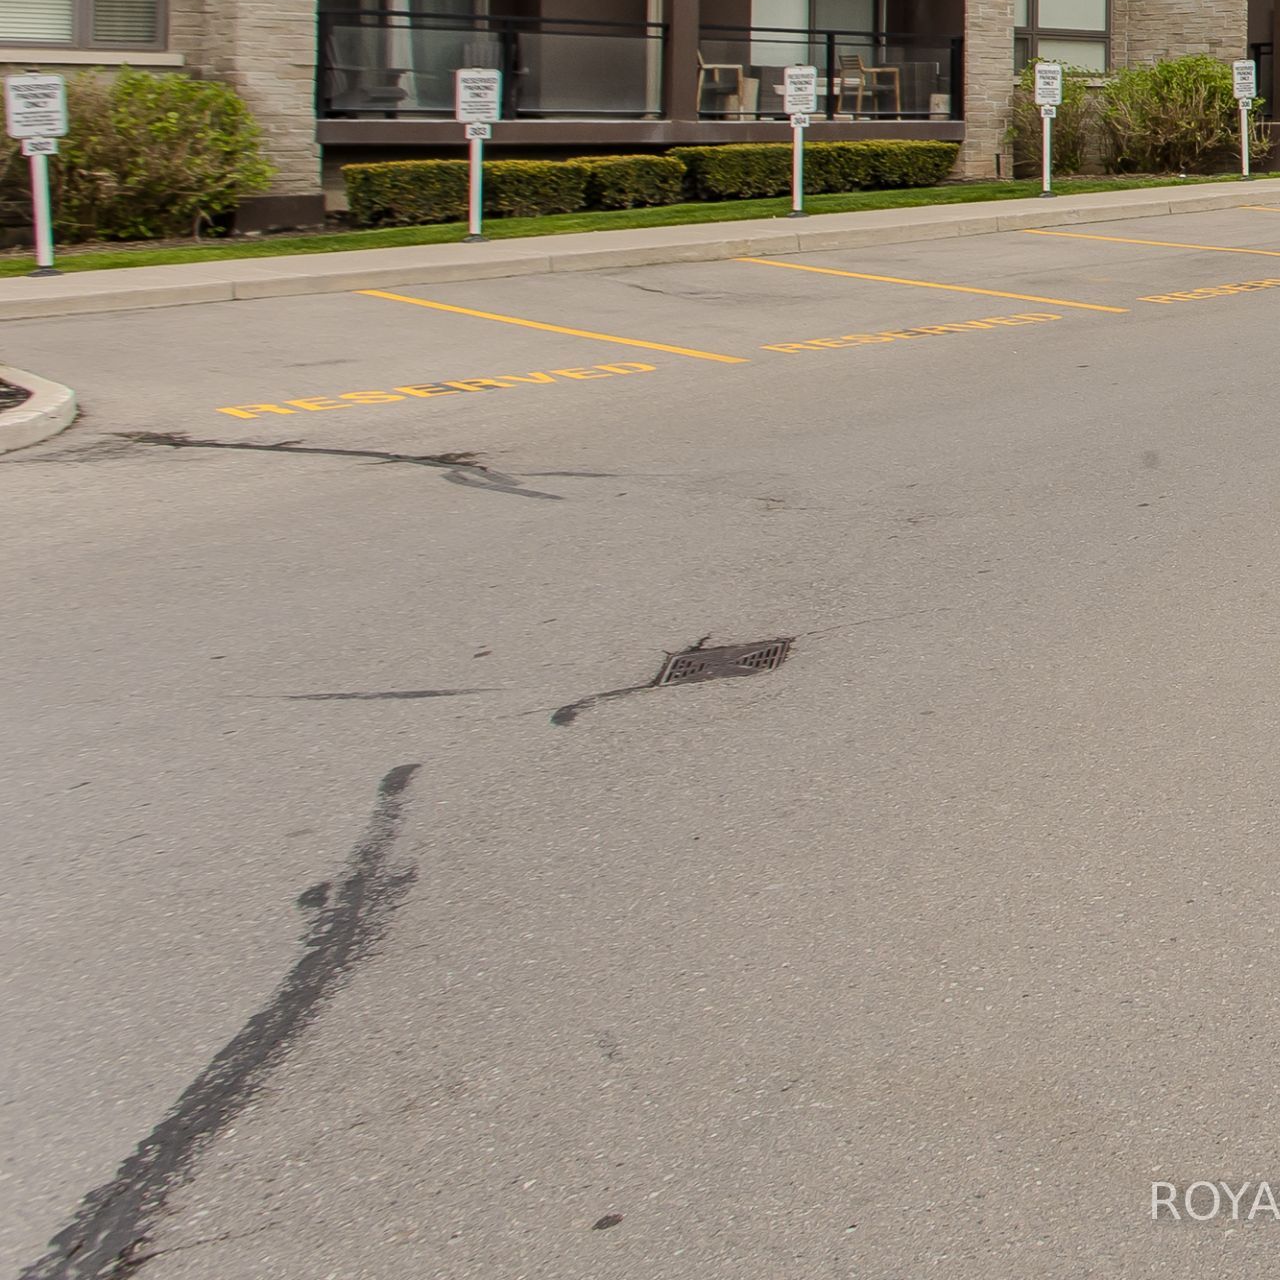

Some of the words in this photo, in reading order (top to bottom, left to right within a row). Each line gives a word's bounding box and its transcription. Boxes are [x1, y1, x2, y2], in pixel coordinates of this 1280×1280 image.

[10, 83, 62, 93] RESERVED
[15, 92, 57, 100] PARKING
[23, 100, 49, 109] ONLY
[793, 117, 807, 125] 304
[469, 127, 488, 136] 303
[760, 311, 1065, 354] RESERVED
[216, 361, 657, 419] RESERVED
